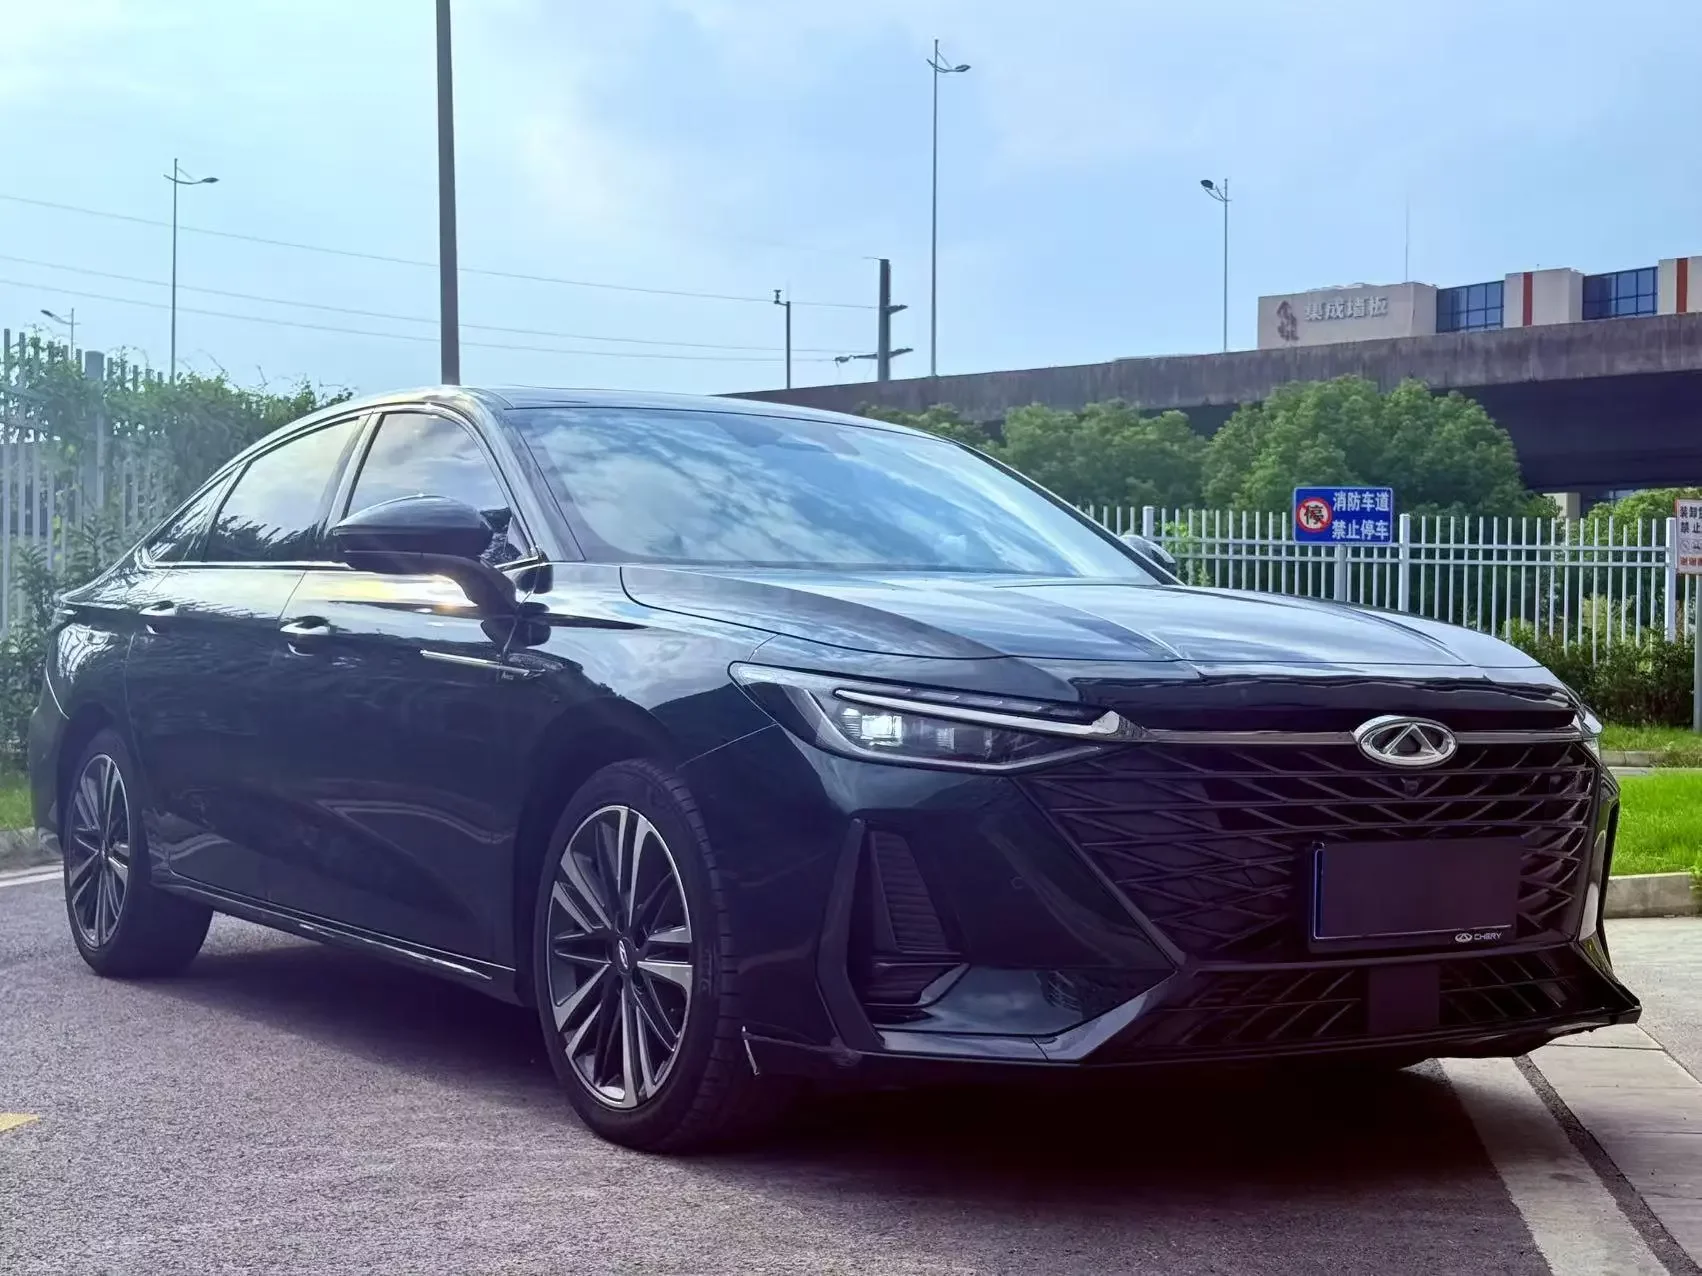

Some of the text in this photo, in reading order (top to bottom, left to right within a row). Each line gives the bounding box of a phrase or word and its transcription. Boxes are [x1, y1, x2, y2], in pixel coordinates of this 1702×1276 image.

[1333, 491, 1390, 512] 消防车道
[1304, 504, 1324, 525] 停
[1332, 519, 1389, 540] 禁止停车
[1474, 932, 1502, 941] CHERY
